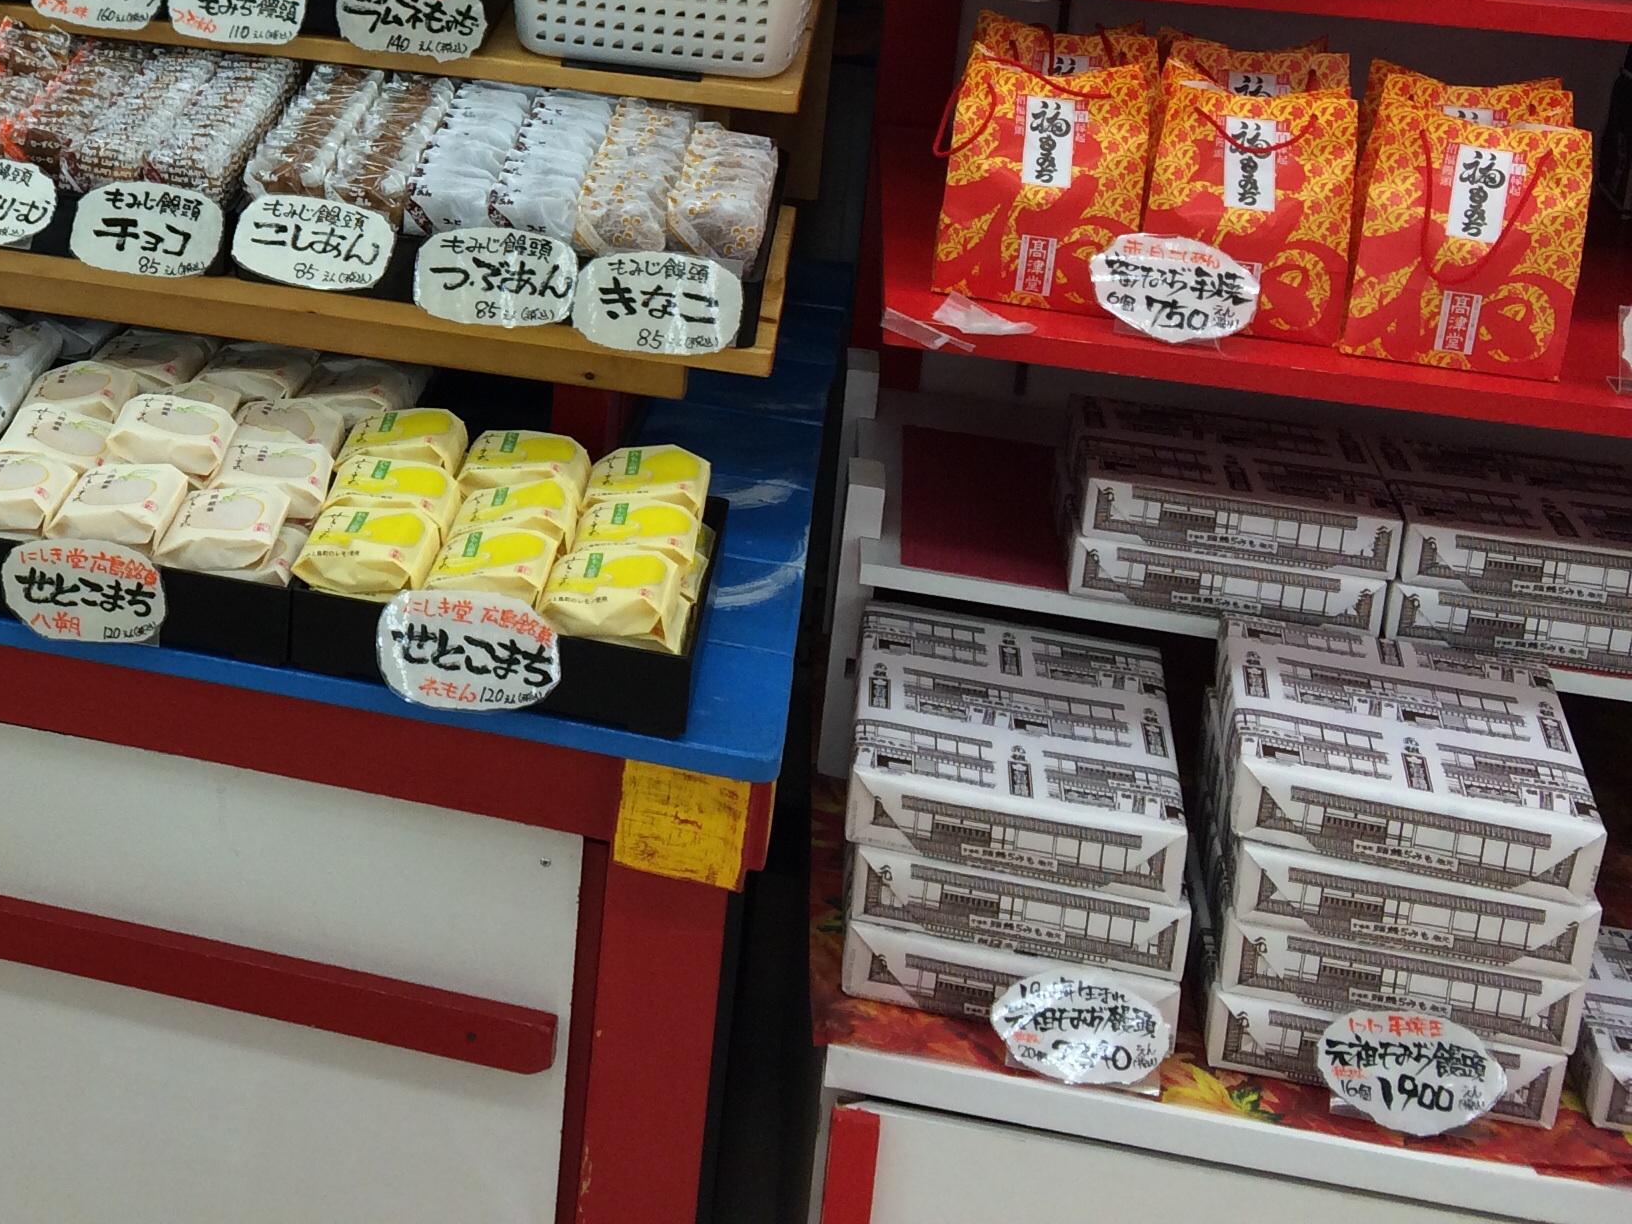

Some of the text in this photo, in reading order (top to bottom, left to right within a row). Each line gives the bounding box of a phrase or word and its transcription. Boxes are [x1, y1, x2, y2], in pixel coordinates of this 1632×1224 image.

[97, 8, 114, 22] 160
[228, 24, 250, 40] 110
[386, 34, 411, 52] 140
[104, 188, 204, 223] もみじ饅頭
[262, 199, 371, 232] もみじ饅頭
[93, 217, 192, 257] チョコ
[251, 220, 380, 266] こしあん
[439, 232, 553, 264] もみじ饅頭
[138, 257, 161, 275] 85
[293, 262, 319, 281] 85
[429, 256, 570, 299] つぶあん
[609, 256, 710, 284] もみじ饅頭
[474, 300, 499, 319] 85
[598, 276, 719, 325] きなこ
[1145, 294, 1209, 331] 750
[635, 329, 662, 349] 85
[20, 547, 88, 569] にしき堂
[14, 567, 156, 617] せとこまち
[31, 612, 121, 639] 八朔 120
[403, 597, 554, 648] にしき堂 広島銘菓
[391, 623, 553, 687] せとこまち
[418, 677, 504, 704] れもん 120
[1378, 1073, 1454, 1112] 1900
